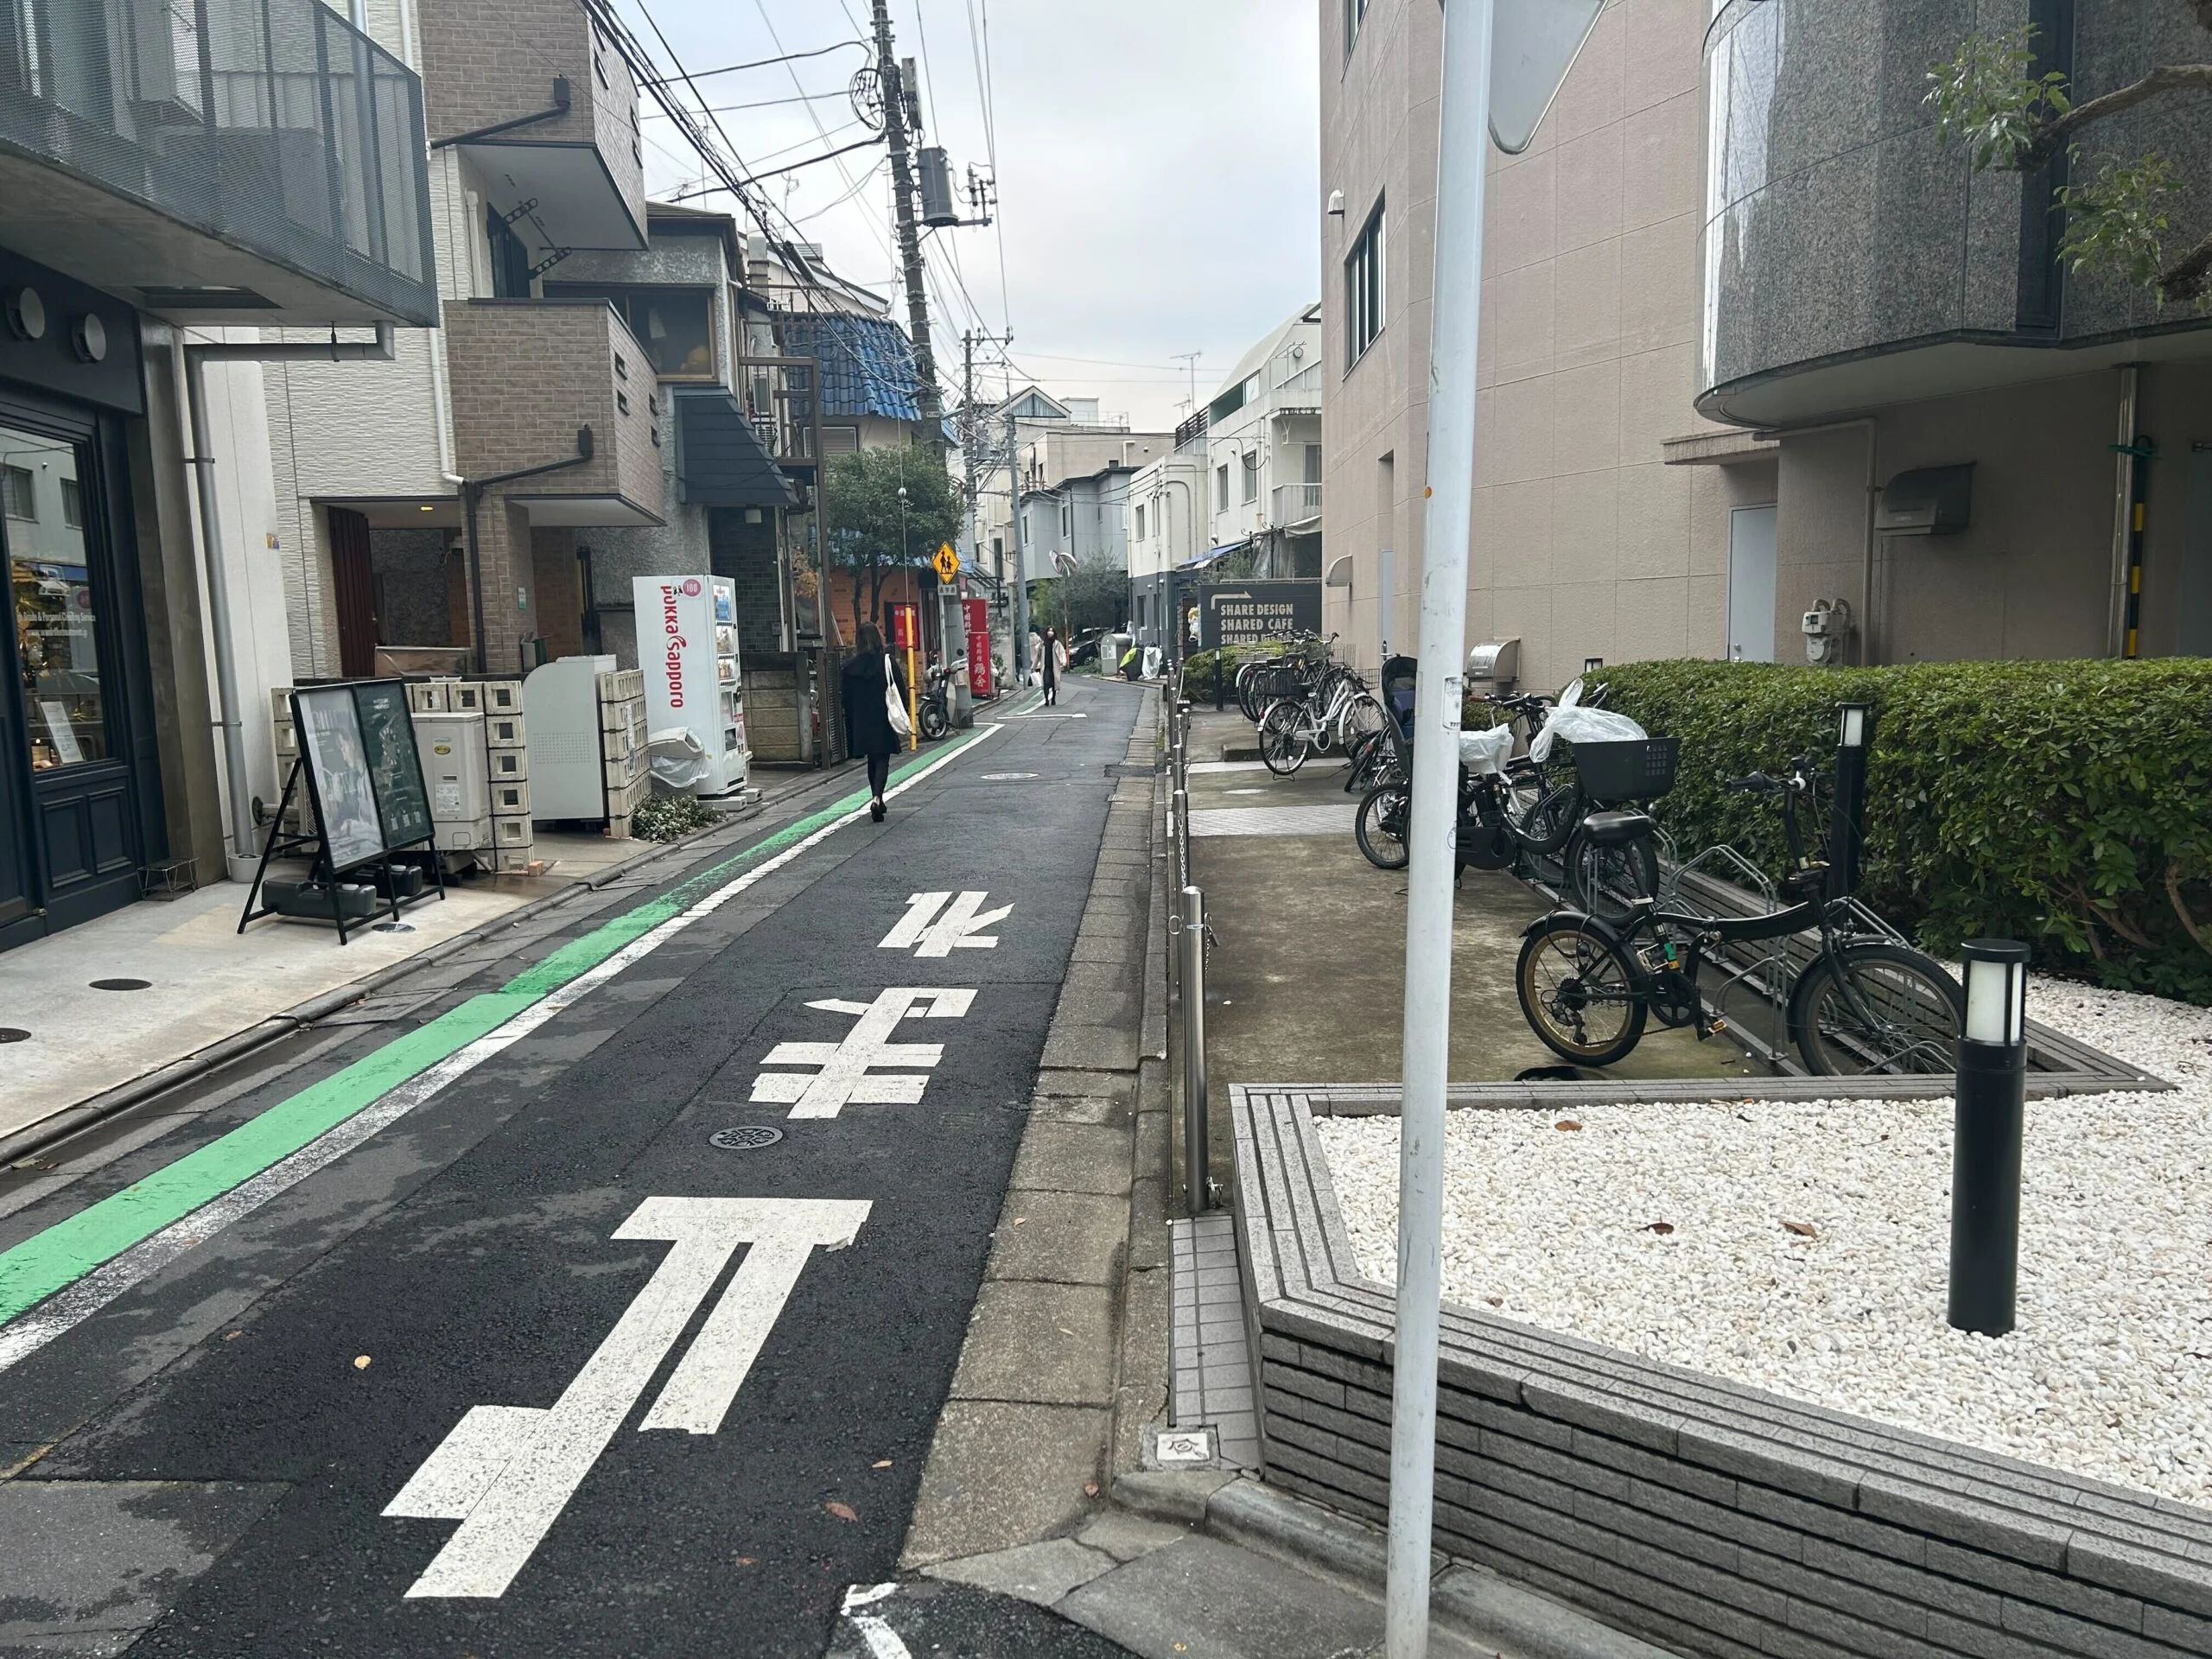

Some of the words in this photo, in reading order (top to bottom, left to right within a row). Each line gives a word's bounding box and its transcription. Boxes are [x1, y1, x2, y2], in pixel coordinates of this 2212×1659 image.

[1220, 604, 1255, 616] SHARE
[1256, 603, 1294, 615] DESIGN
[1220, 619, 1264, 631] SHARED
[1267, 618, 1294, 630] CAFE
[1221, 633, 1258, 645] SHARED
